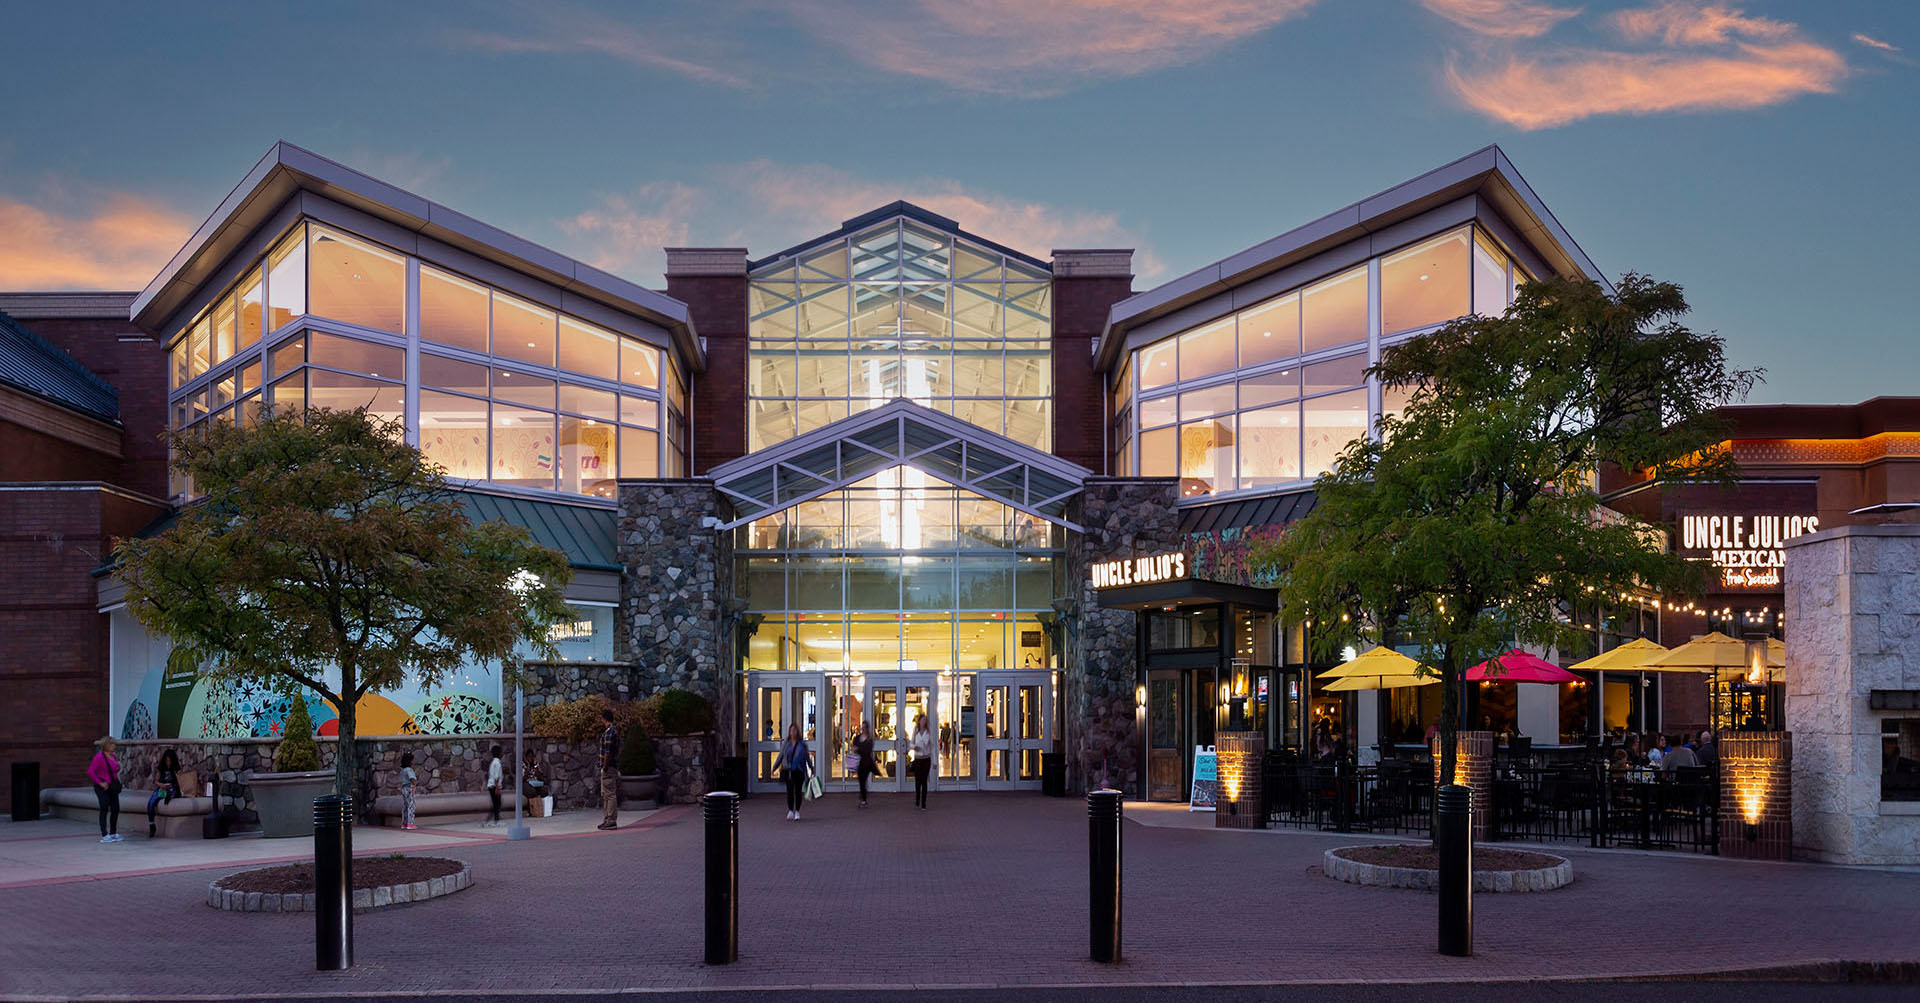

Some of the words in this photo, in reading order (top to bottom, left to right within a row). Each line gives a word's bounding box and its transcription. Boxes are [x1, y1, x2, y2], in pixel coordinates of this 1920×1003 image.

[1683, 515, 1743, 549] UNCLE
[1748, 515, 1819, 549] JULIO'S
[1092, 560, 1132, 588] UNCLE
[1133, 552, 1185, 583] JULIO'S
